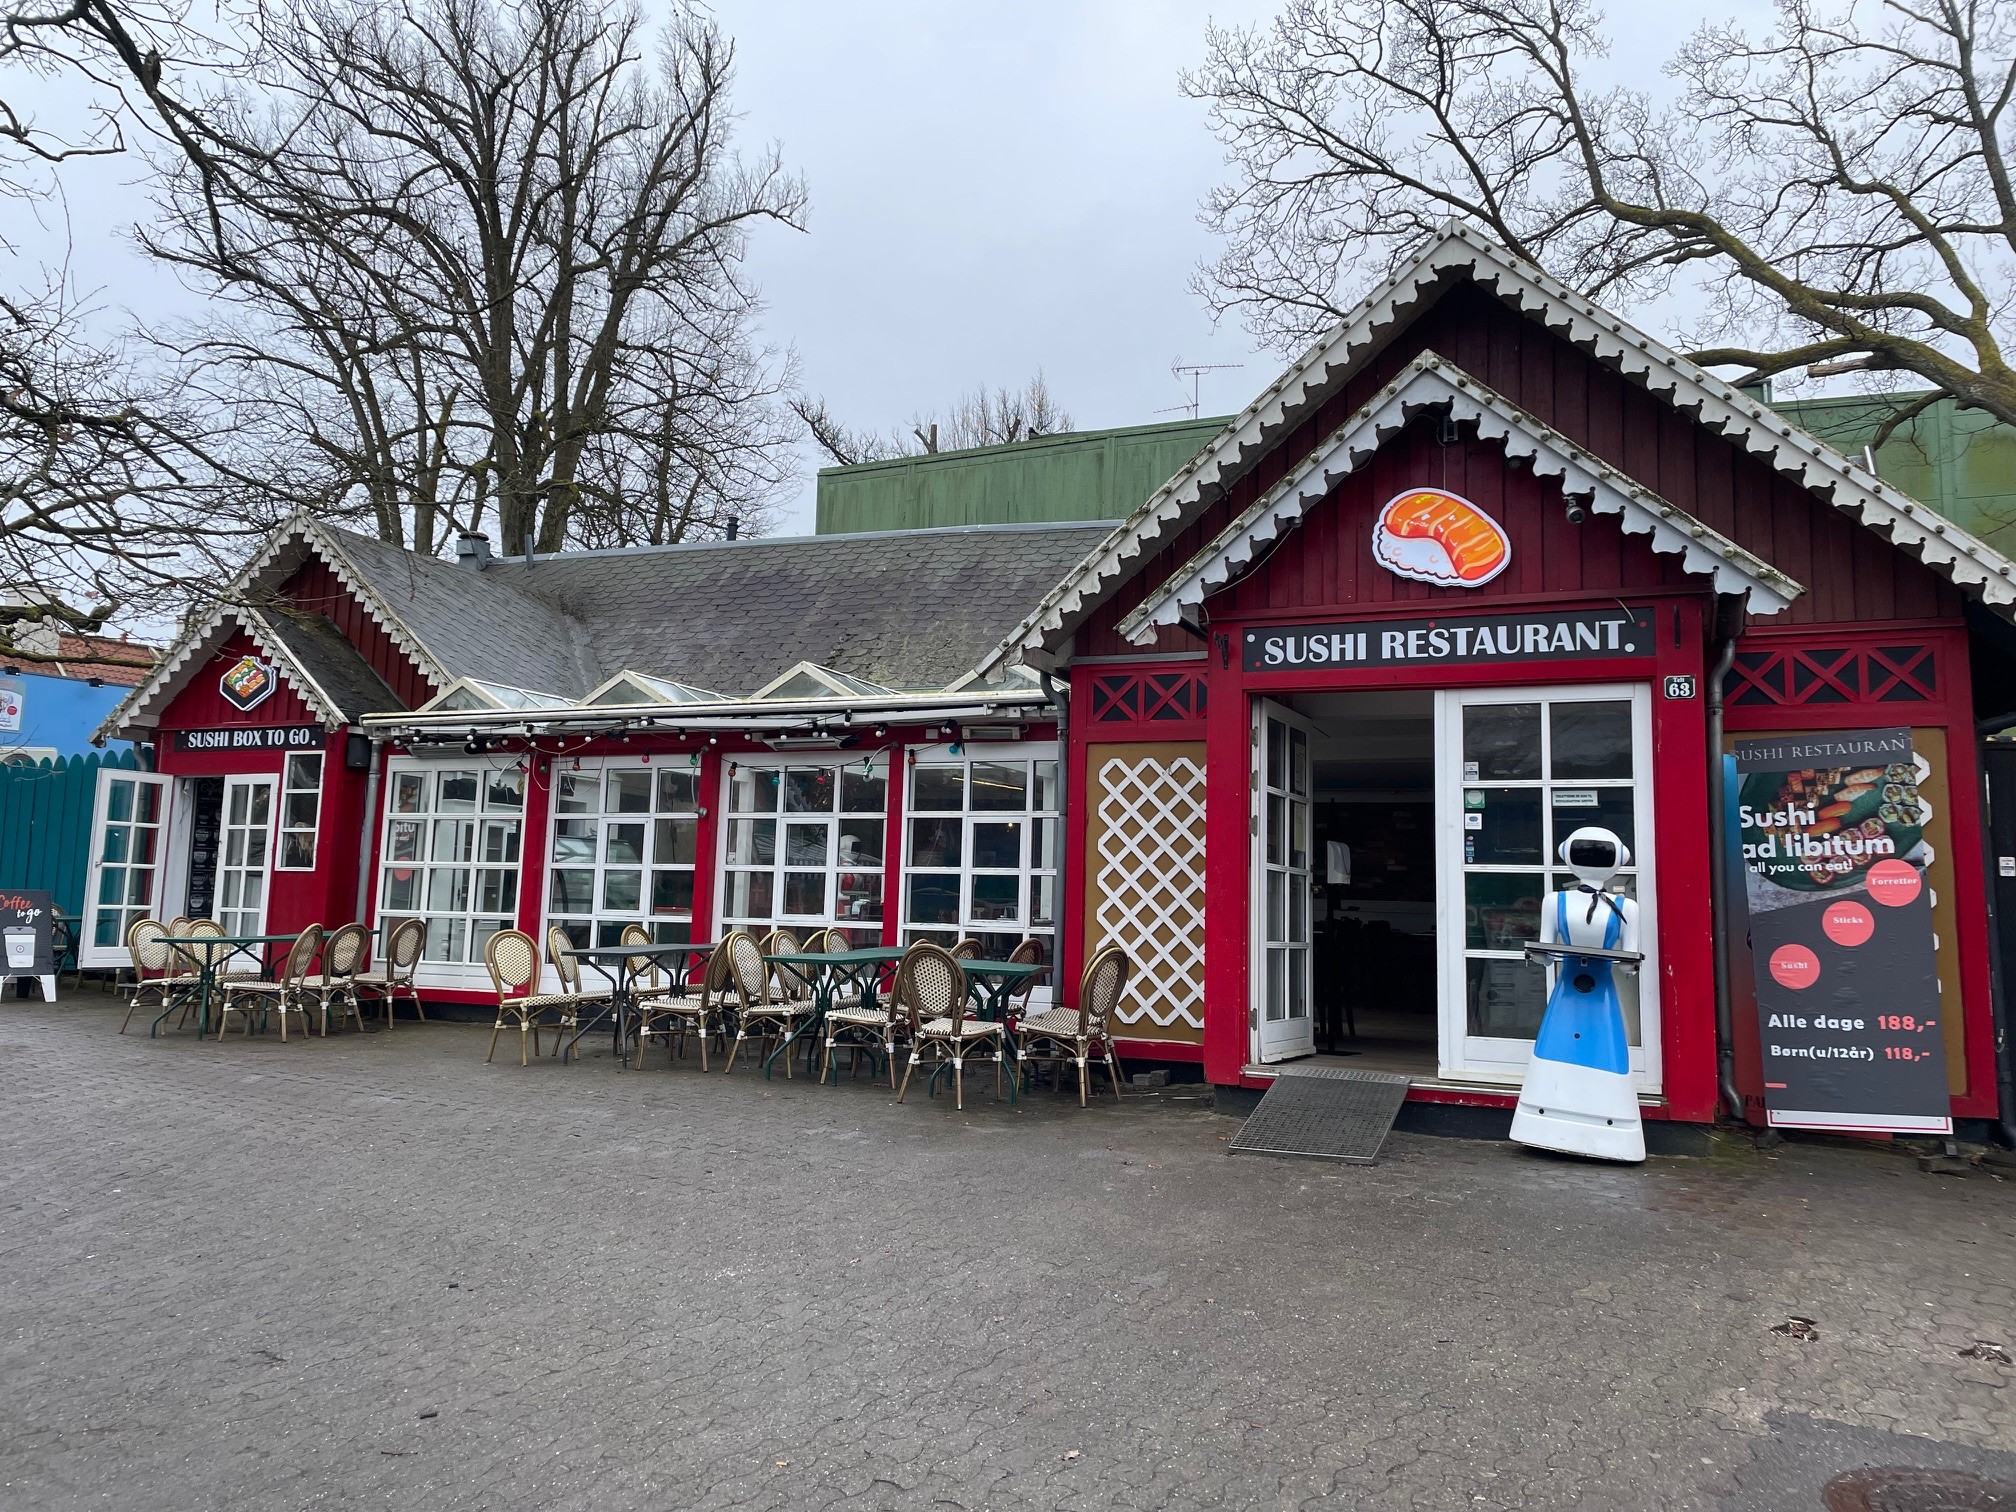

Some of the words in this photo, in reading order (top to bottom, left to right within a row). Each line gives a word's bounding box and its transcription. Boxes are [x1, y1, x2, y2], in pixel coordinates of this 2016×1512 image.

[1264, 632, 1367, 665] SUSHI
[1669, 682, 1690, 697] 63
[188, 731, 229, 748] SUSHI
[233, 730, 262, 747] BOX
[266, 729, 285, 746] TO
[1739, 803, 1816, 828] Sushi
[1743, 836, 1776, 859] ad
[1785, 834, 1895, 857] libitum
[1750, 864, 1766, 873] all
[1769, 865, 1795, 876] you
[1798, 864, 1824, 873] can
[1826, 860, 1854, 872] eat!
[1871, 877, 1918, 886] Forretter
[17, 909, 26, 918] to
[25, 908, 42, 924] go
[1833, 916, 1864, 925] Sticks
[1781, 961, 1808, 970] Sushi
[1768, 1014, 1807, 1029] Alle
[1814, 1015, 1865, 1032] dage
[1877, 1015, 1936, 1033] 188,-
[1771, 1045, 1874, 1062] Børn(u/12år)
[1885, 1047, 1930, 1062] 118,-
